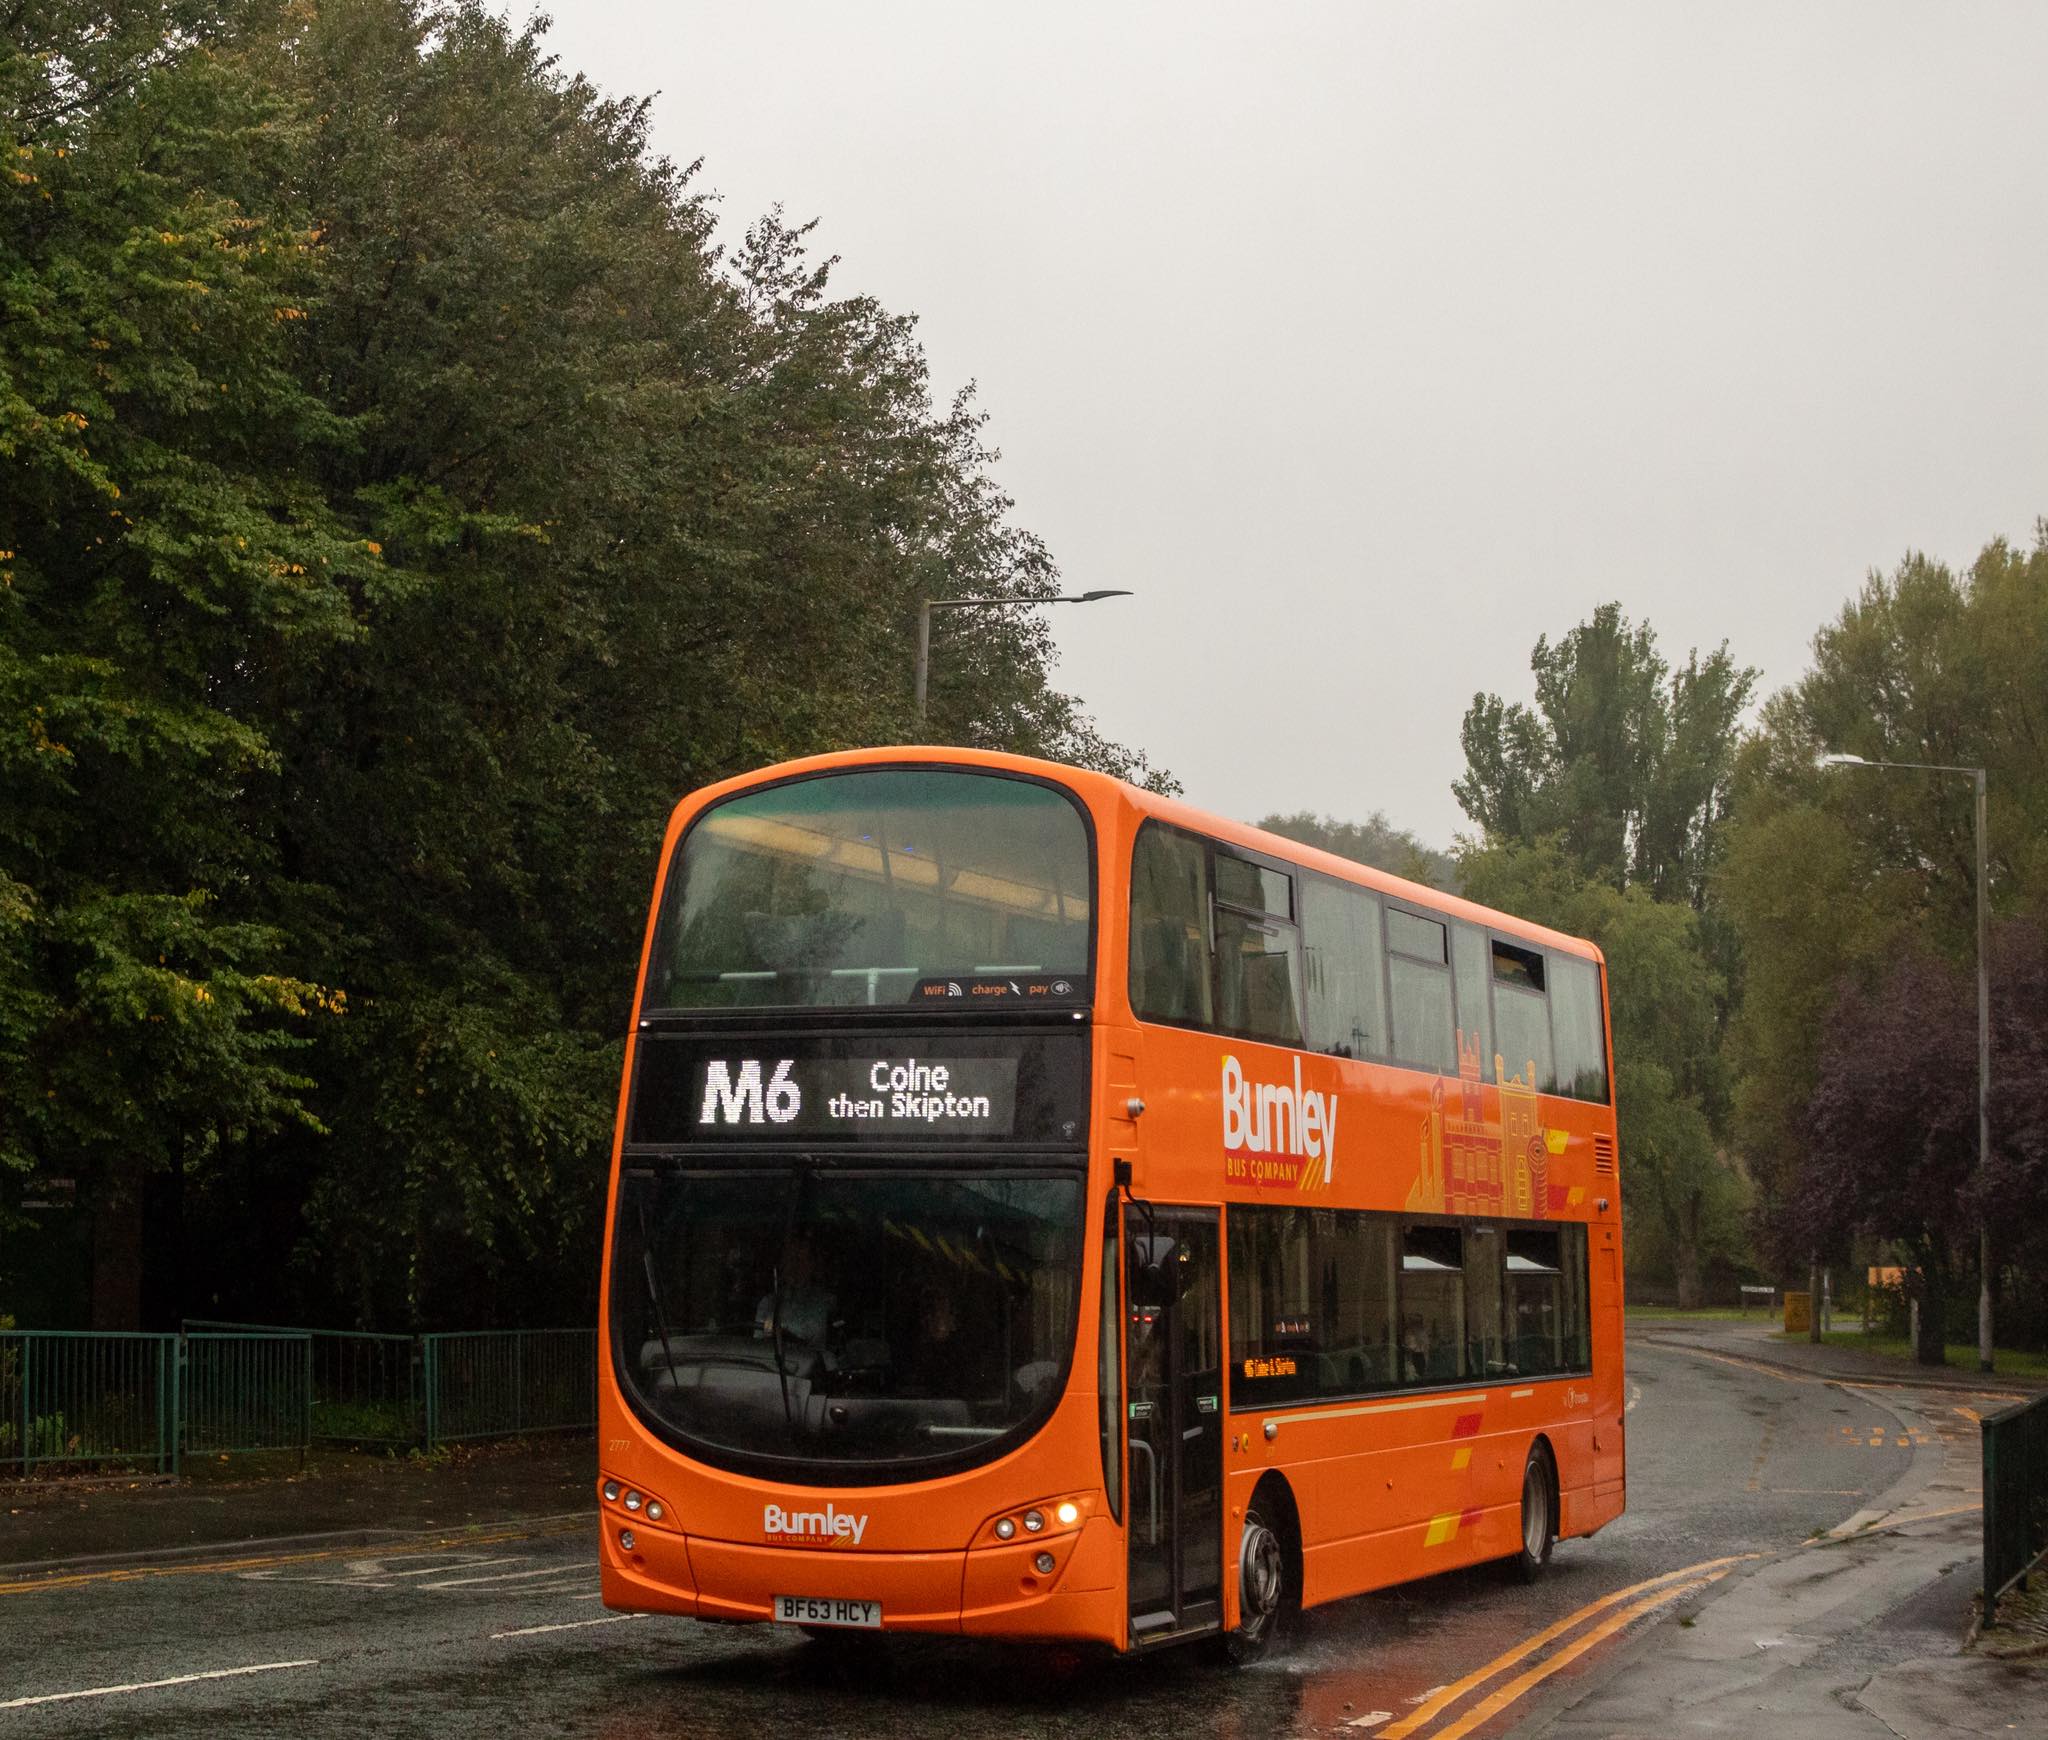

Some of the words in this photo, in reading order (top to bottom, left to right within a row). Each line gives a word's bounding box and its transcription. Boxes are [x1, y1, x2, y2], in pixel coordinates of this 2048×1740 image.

[923, 985, 946, 996] WiFi
[971, 984, 1008, 997] charge
[1028, 985, 1049, 995] pay
[870, 1058, 950, 1092] Colne
[699, 1060, 801, 1123] M6
[828, 1093, 884, 1118] then
[891, 1092, 989, 1122] Skipton
[1222, 1055, 1338, 1184] Burnley
[1227, 1158, 1247, 1178] BUS
[1250, 1161, 1298, 1181] COMPANY
[609, 1439, 631, 1451] 2777
[764, 1503, 868, 1545] Burnley
[783, 1599, 831, 1620] BF63
[836, 1602, 872, 1622] HCY
